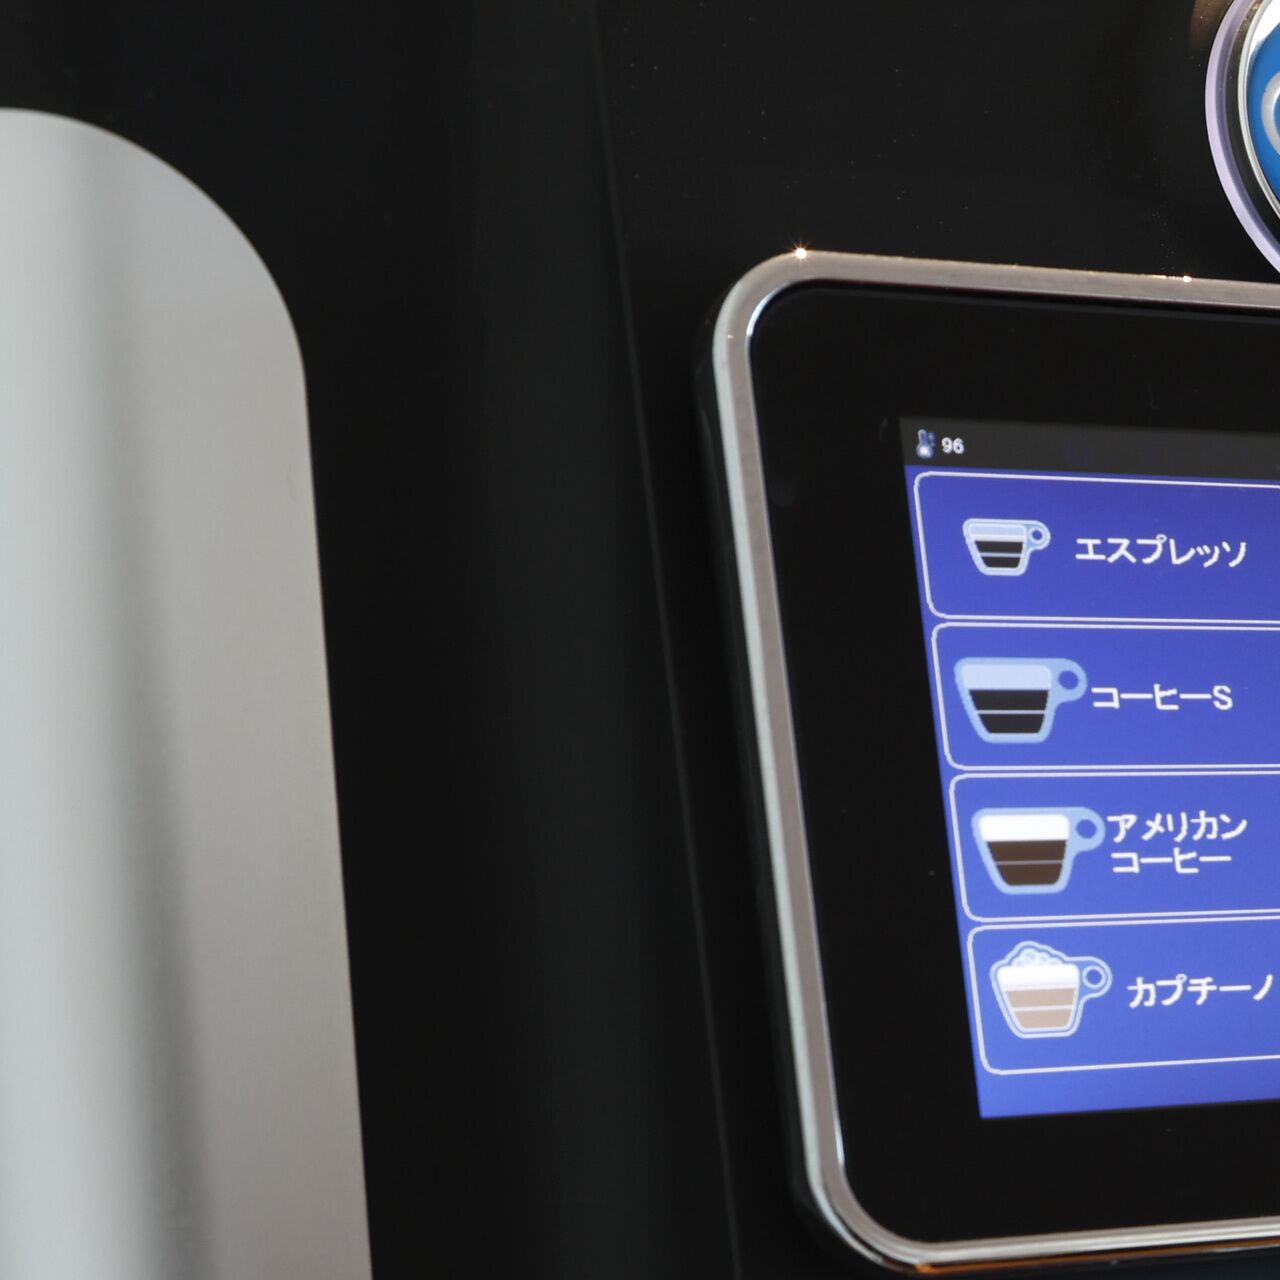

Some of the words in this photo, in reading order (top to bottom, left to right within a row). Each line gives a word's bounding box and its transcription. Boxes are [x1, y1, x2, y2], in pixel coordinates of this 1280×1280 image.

[941, 437, 965, 455] 96
[1075, 533, 1247, 568] エスプレッソ
[1090, 683, 1233, 711] コーヒーS
[1106, 810, 1248, 844] アメリカン
[1110, 846, 1232, 874] コーヒー
[1127, 973, 1274, 1009] カプチーノ
